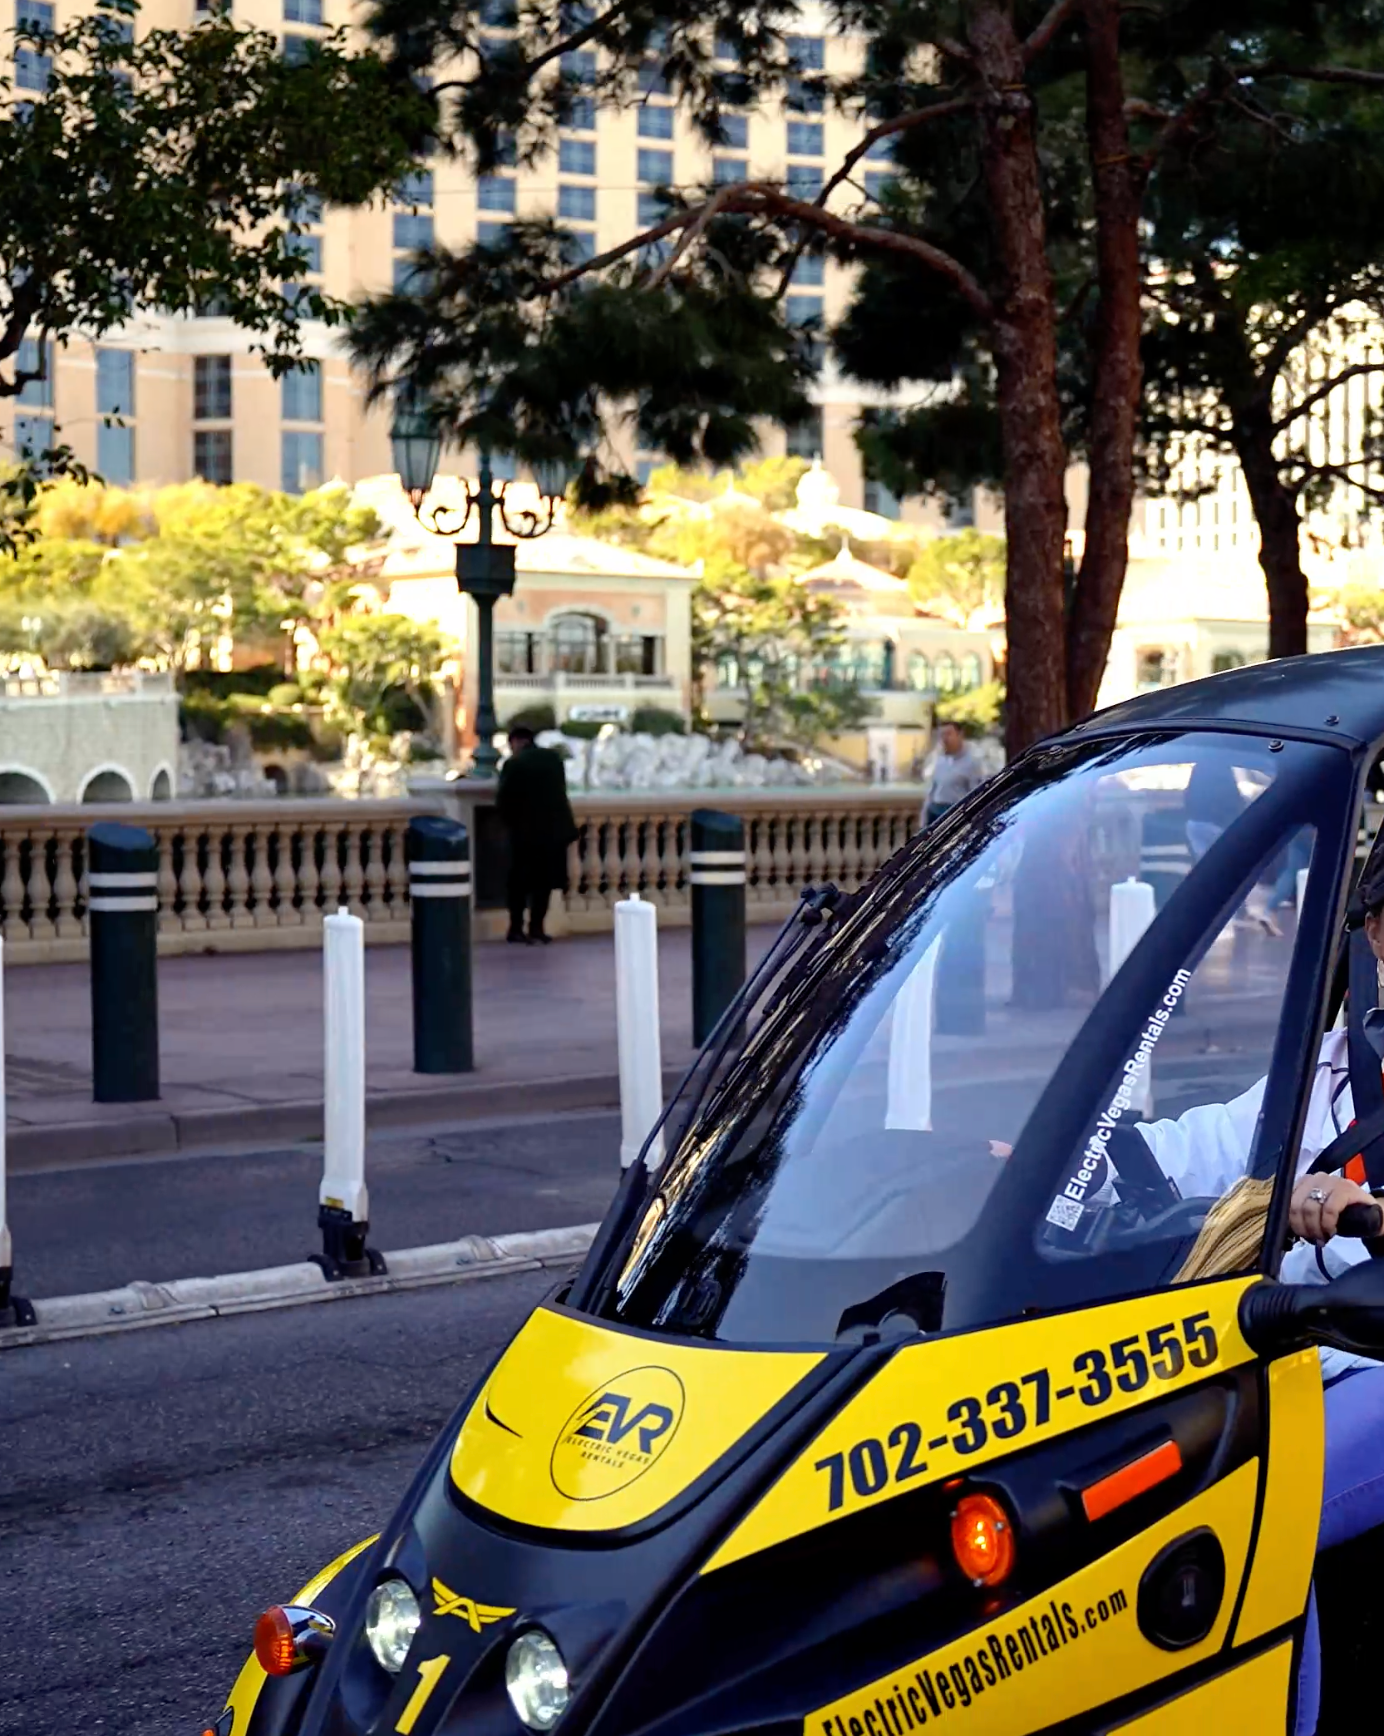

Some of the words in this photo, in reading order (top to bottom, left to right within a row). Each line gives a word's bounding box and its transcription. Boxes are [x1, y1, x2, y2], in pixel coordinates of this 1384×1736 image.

[1064, 968, 1191, 1201] ElectricVegasRentals.com
[574, 1392, 673, 1455] EVR
[815, 1311, 1220, 1512] 702-337-3555
[395, 1654, 450, 1736] 1
